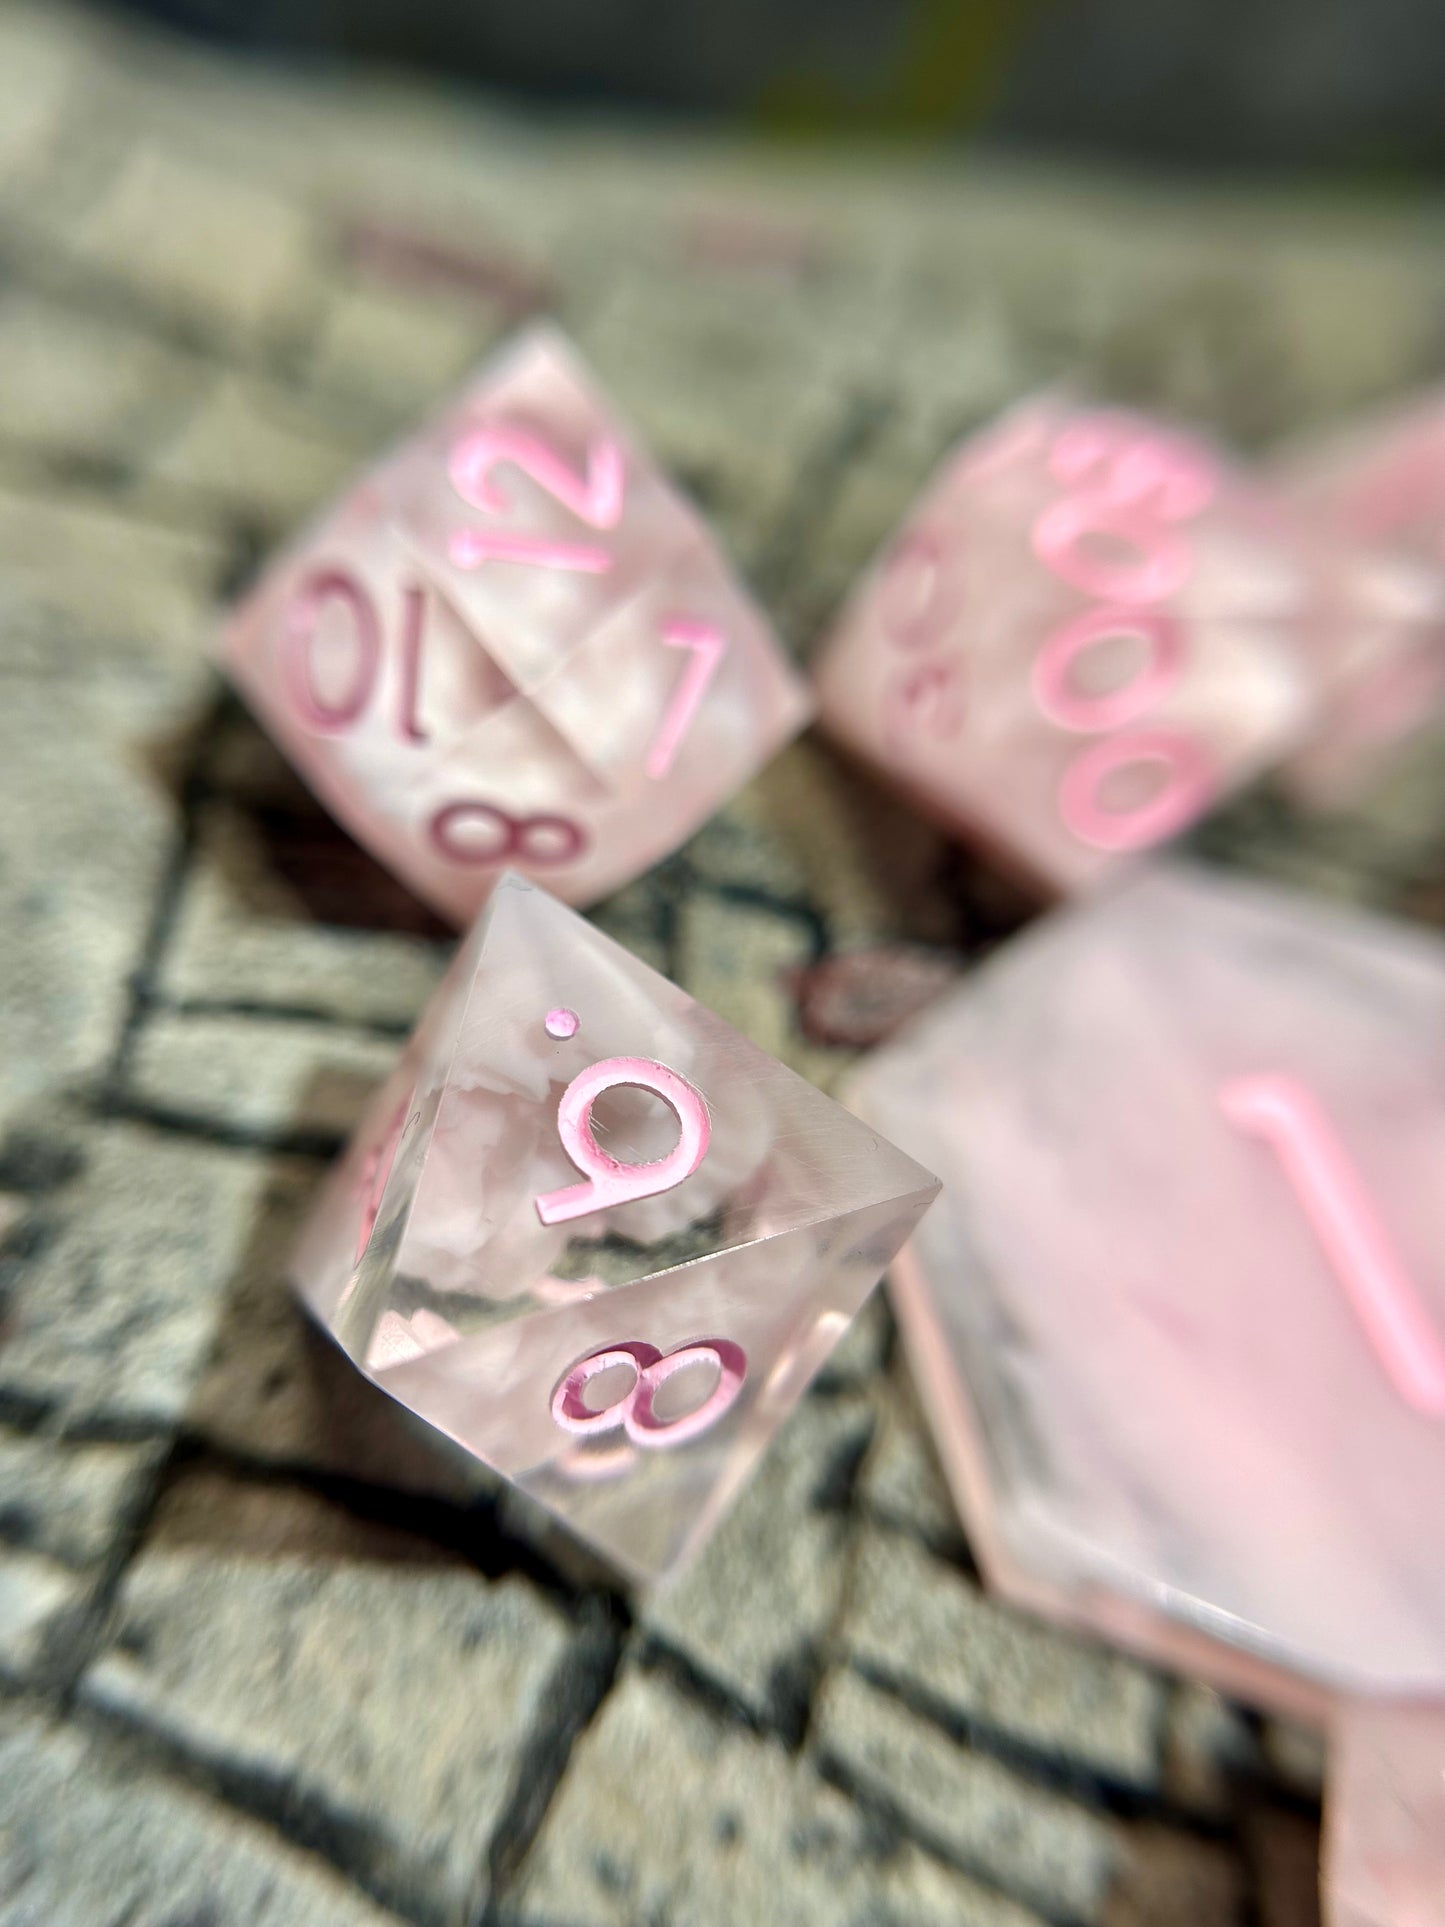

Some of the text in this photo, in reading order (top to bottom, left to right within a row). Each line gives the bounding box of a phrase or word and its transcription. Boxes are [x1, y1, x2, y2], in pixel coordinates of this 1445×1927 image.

[448, 418, 627, 574] 12
[426, 800, 590, 867] 8
[550, 1337, 748, 1448] 8
